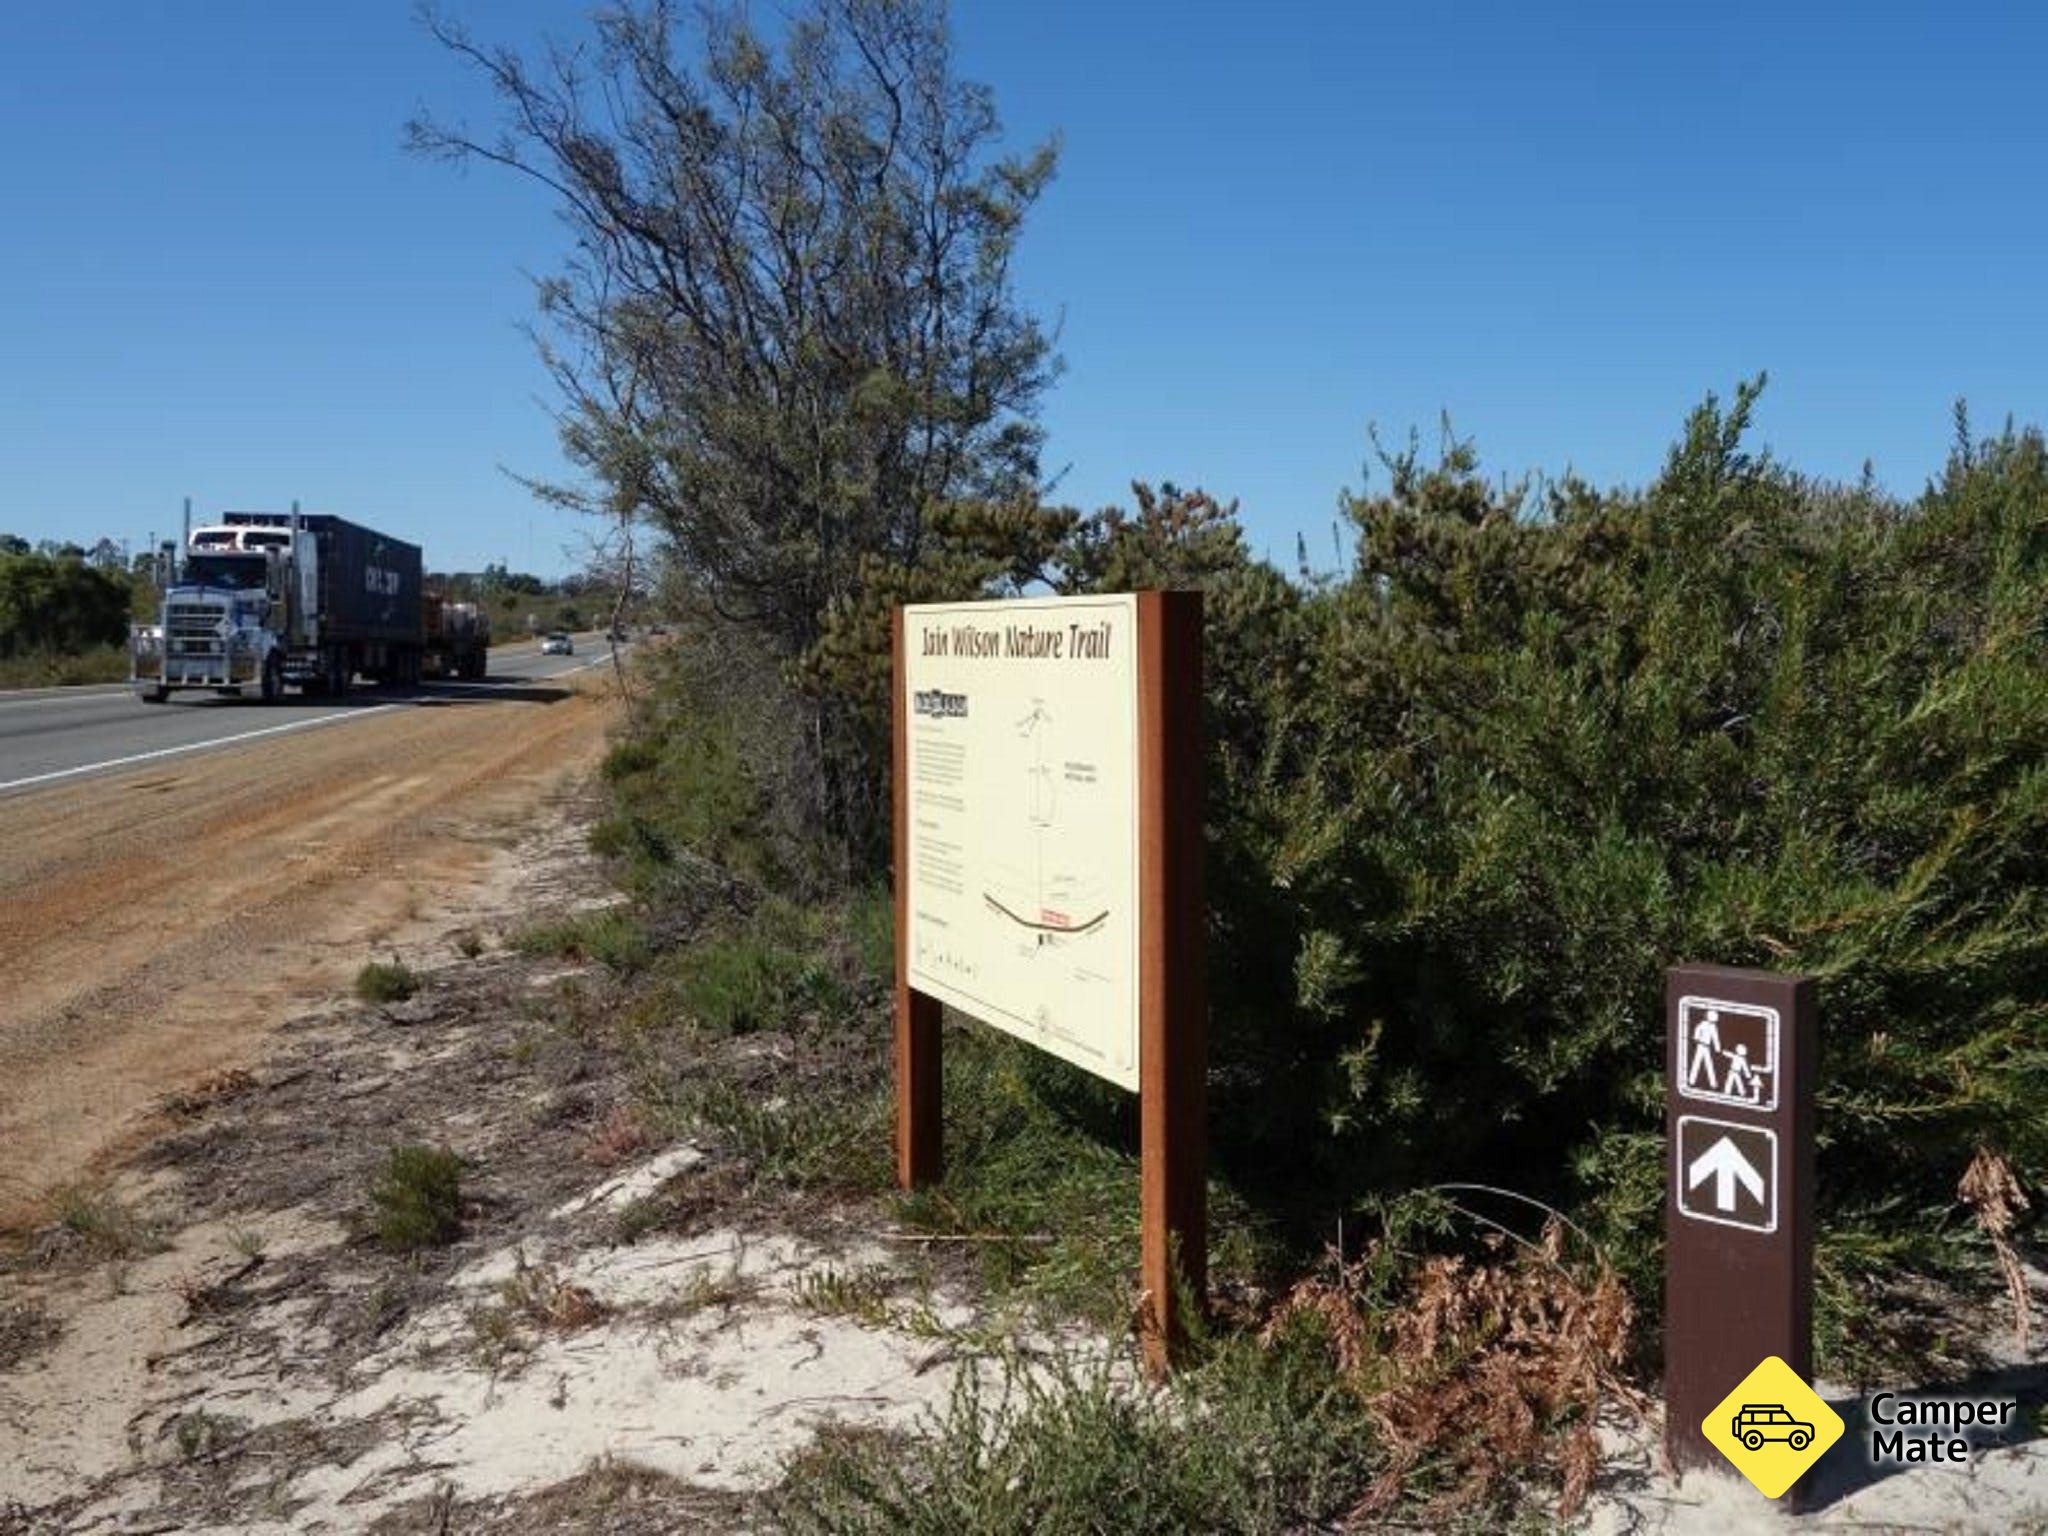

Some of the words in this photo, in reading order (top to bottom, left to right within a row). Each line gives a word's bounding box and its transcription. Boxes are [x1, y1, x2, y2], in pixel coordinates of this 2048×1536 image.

[922, 626, 948, 656] Iain
[952, 624, 999, 658] Wilson
[1004, 624, 1063, 659] Nature
[1070, 620, 1112, 659] Trail
